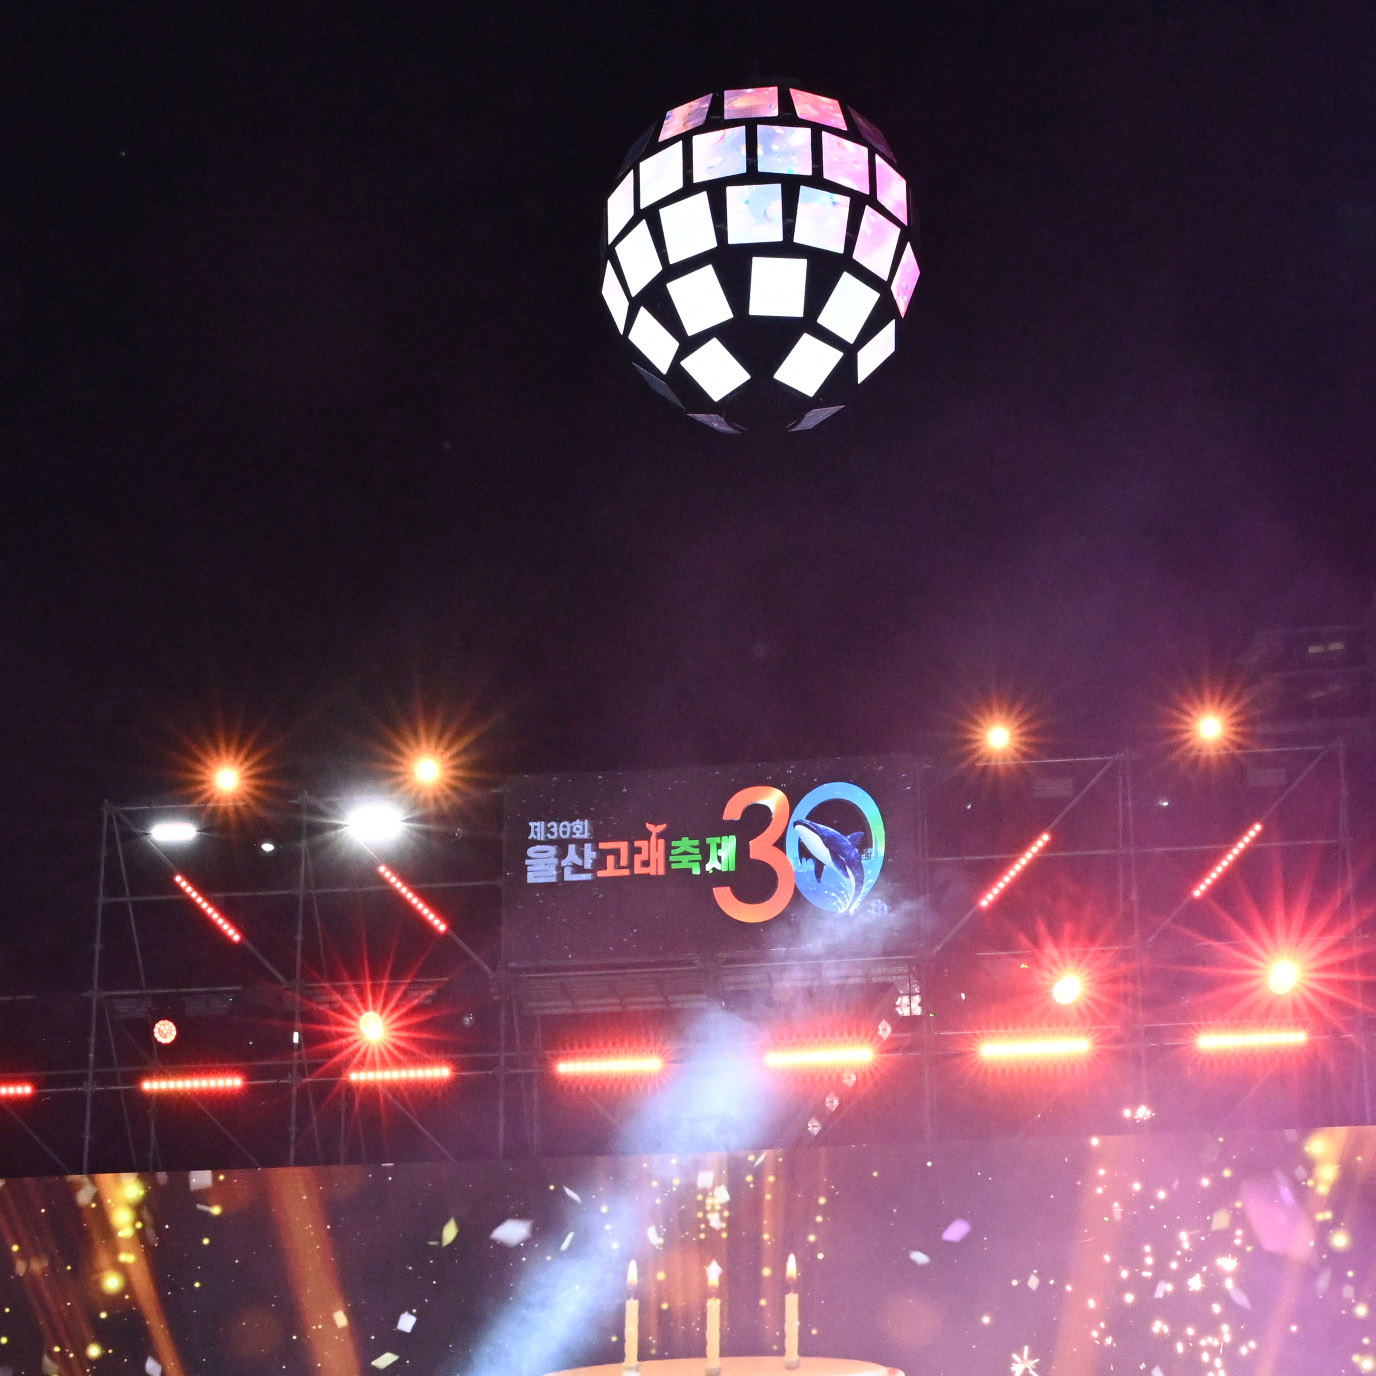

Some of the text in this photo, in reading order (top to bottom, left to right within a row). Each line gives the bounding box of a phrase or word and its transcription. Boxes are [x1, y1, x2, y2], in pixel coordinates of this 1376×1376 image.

[525, 822, 737, 884] 울산고래축제
[528, 818, 590, 841] 제30회
[712, 782, 886, 922] 30
